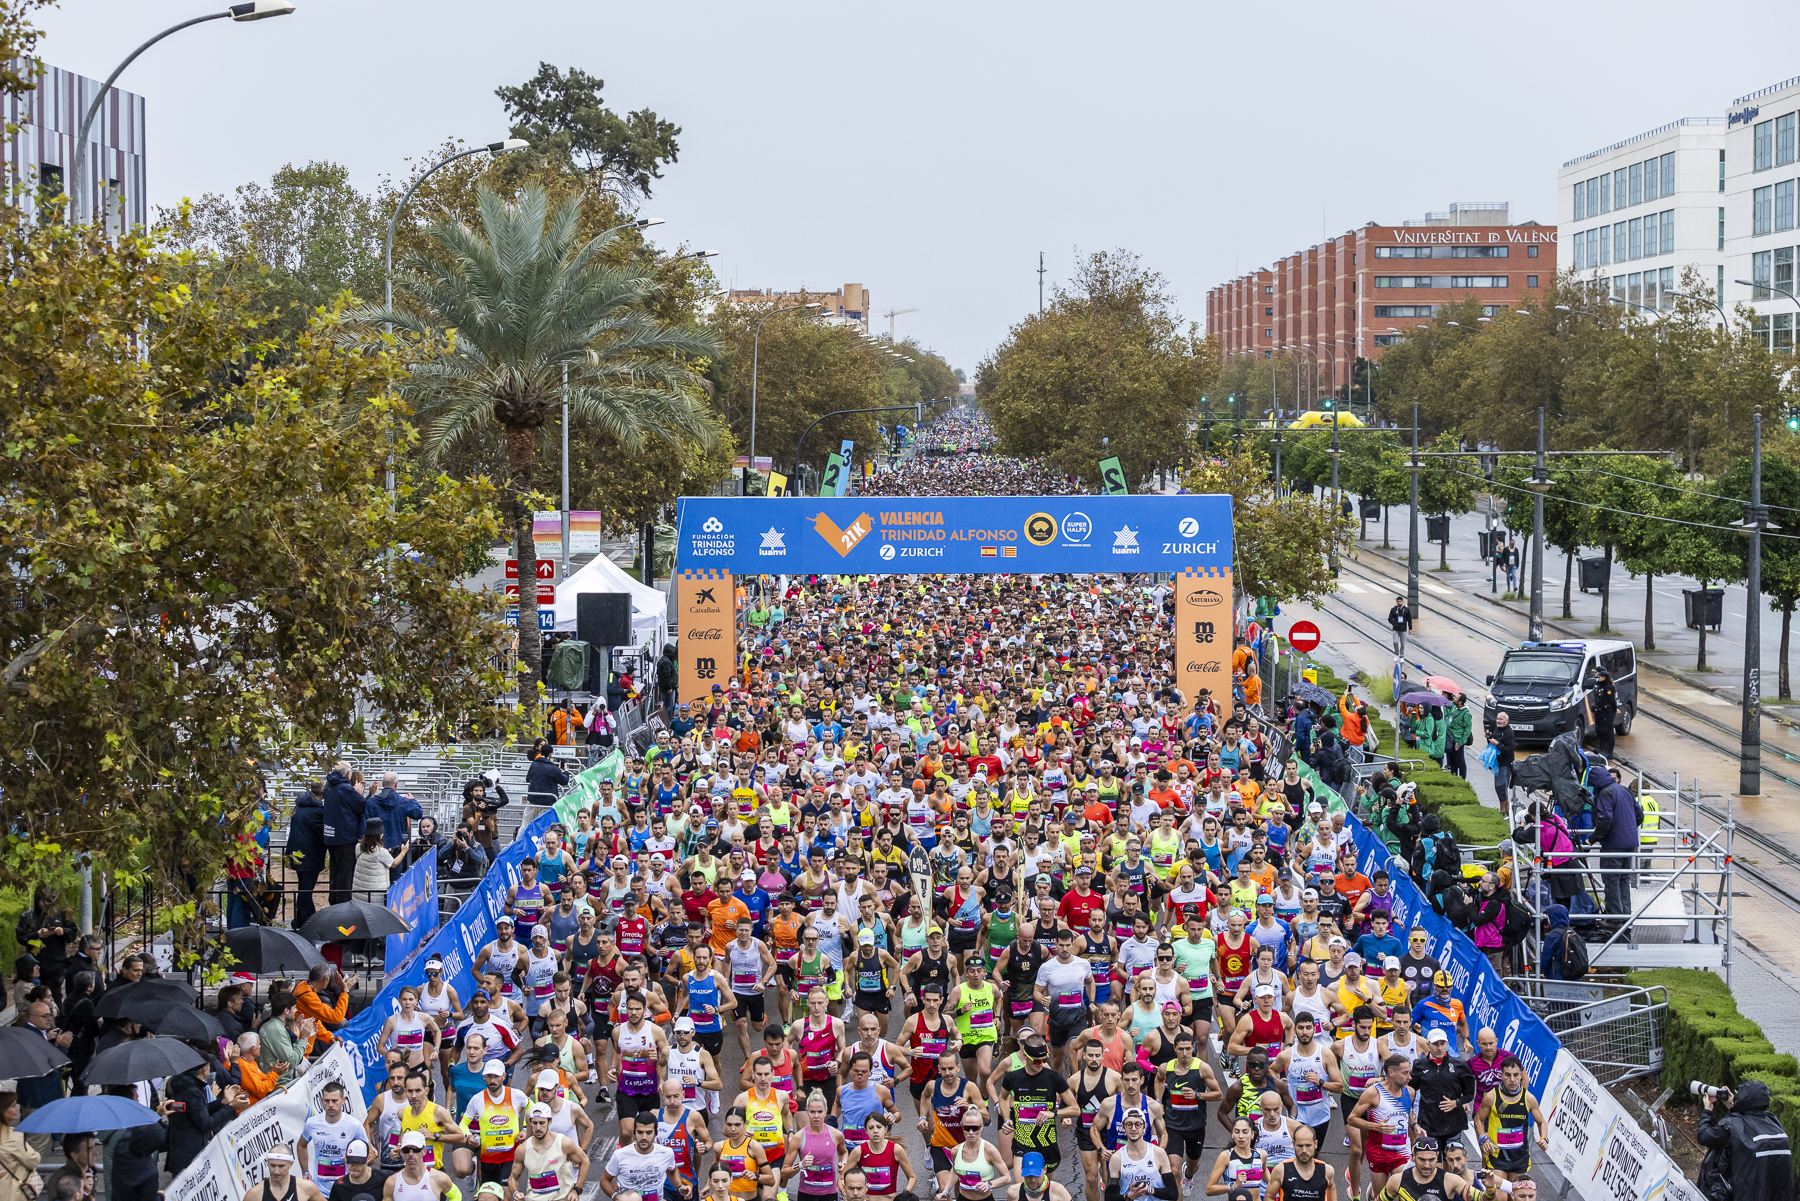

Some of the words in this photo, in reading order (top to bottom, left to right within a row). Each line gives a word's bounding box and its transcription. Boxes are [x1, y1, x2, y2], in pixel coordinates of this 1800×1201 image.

[842, 448, 852, 468] 3
[824, 464, 840, 488] 2
[880, 512, 944, 526] VALENCIA
[841, 521, 866, 550] 21K
[880, 529, 946, 541] TRINIDAD
[950, 529, 1018, 541] ALFONSO
[759, 548, 786, 556] luanvi
[900, 548, 943, 557] ZURICH
[1162, 543, 1216, 554] ZURICH
[540, 614, 553, 626] 14
[469, 911, 487, 947] ZURICH
[1514, 1039, 1543, 1087] ZURICH
